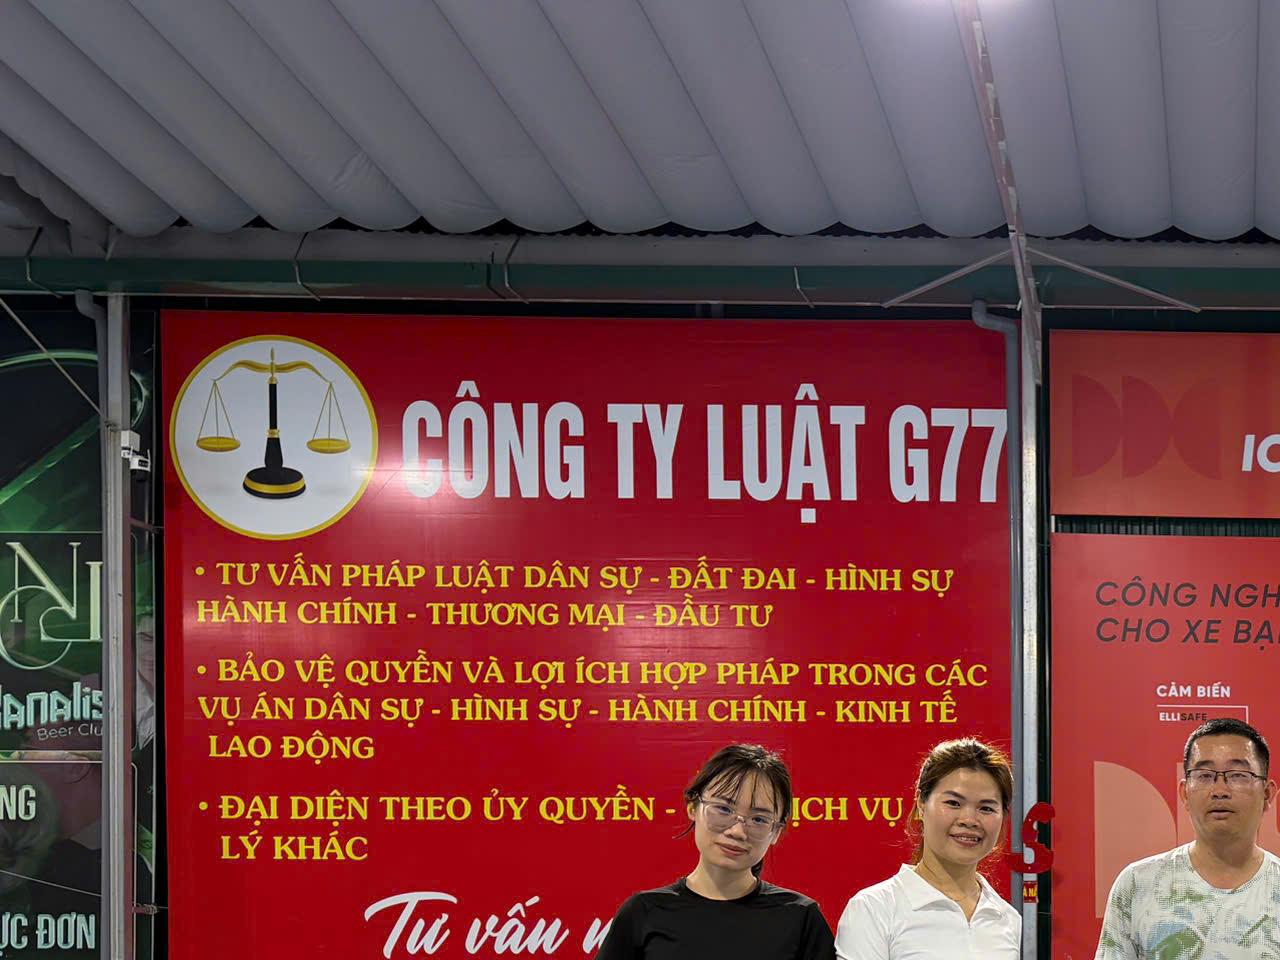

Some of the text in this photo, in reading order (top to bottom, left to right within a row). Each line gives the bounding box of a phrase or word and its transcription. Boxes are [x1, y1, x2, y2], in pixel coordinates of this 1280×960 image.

[402, 381, 1008, 523] CÔNG TY LUẬT G77
[216, 553, 954, 597] TƯ VẤN PHÁP LUẬT DÂN SỰ ĐẤT ĐAI HÌNH SỰ
[1095, 576, 1198, 608] CÔNG
[197, 593, 774, 632] HÀNH CHÍNH THƯƠNG MẠI ĐẦU TƯ
[1095, 617, 1171, 644] CHO
[1181, 619, 1222, 644] XE
[218, 649, 988, 690] BẢO VỆ QUYỀN VÀ LỢI ÍCH HỢP PHÁP TRONG CÁC
[1157, 682, 1231, 698] CẢM BIẾN
[199, 690, 958, 728] VỤ ÁN DÂN SỰ HÌNH SỰ HÀNH CHÍNH KINH TẾ
[37, 720, 103, 741] Beer Clu
[208, 729, 375, 765] LAO ĐỘNG
[219, 795, 279, 826] ĐẠI
[290, 788, 369, 828] DIỆN
[379, 797, 472, 821] THEO
[482, 788, 529, 821] ỦY
[538, 784, 655, 823] QUYỀN
[790, 797, 849, 828] ỊCH
[858, 797, 903, 828] VỤ
[220, 830, 368, 860] LÝ KHÁC
[36, 912, 96, 949] ĐƠN
[364, 892, 458, 960] Tư
[464, 895, 570, 958] vấn
